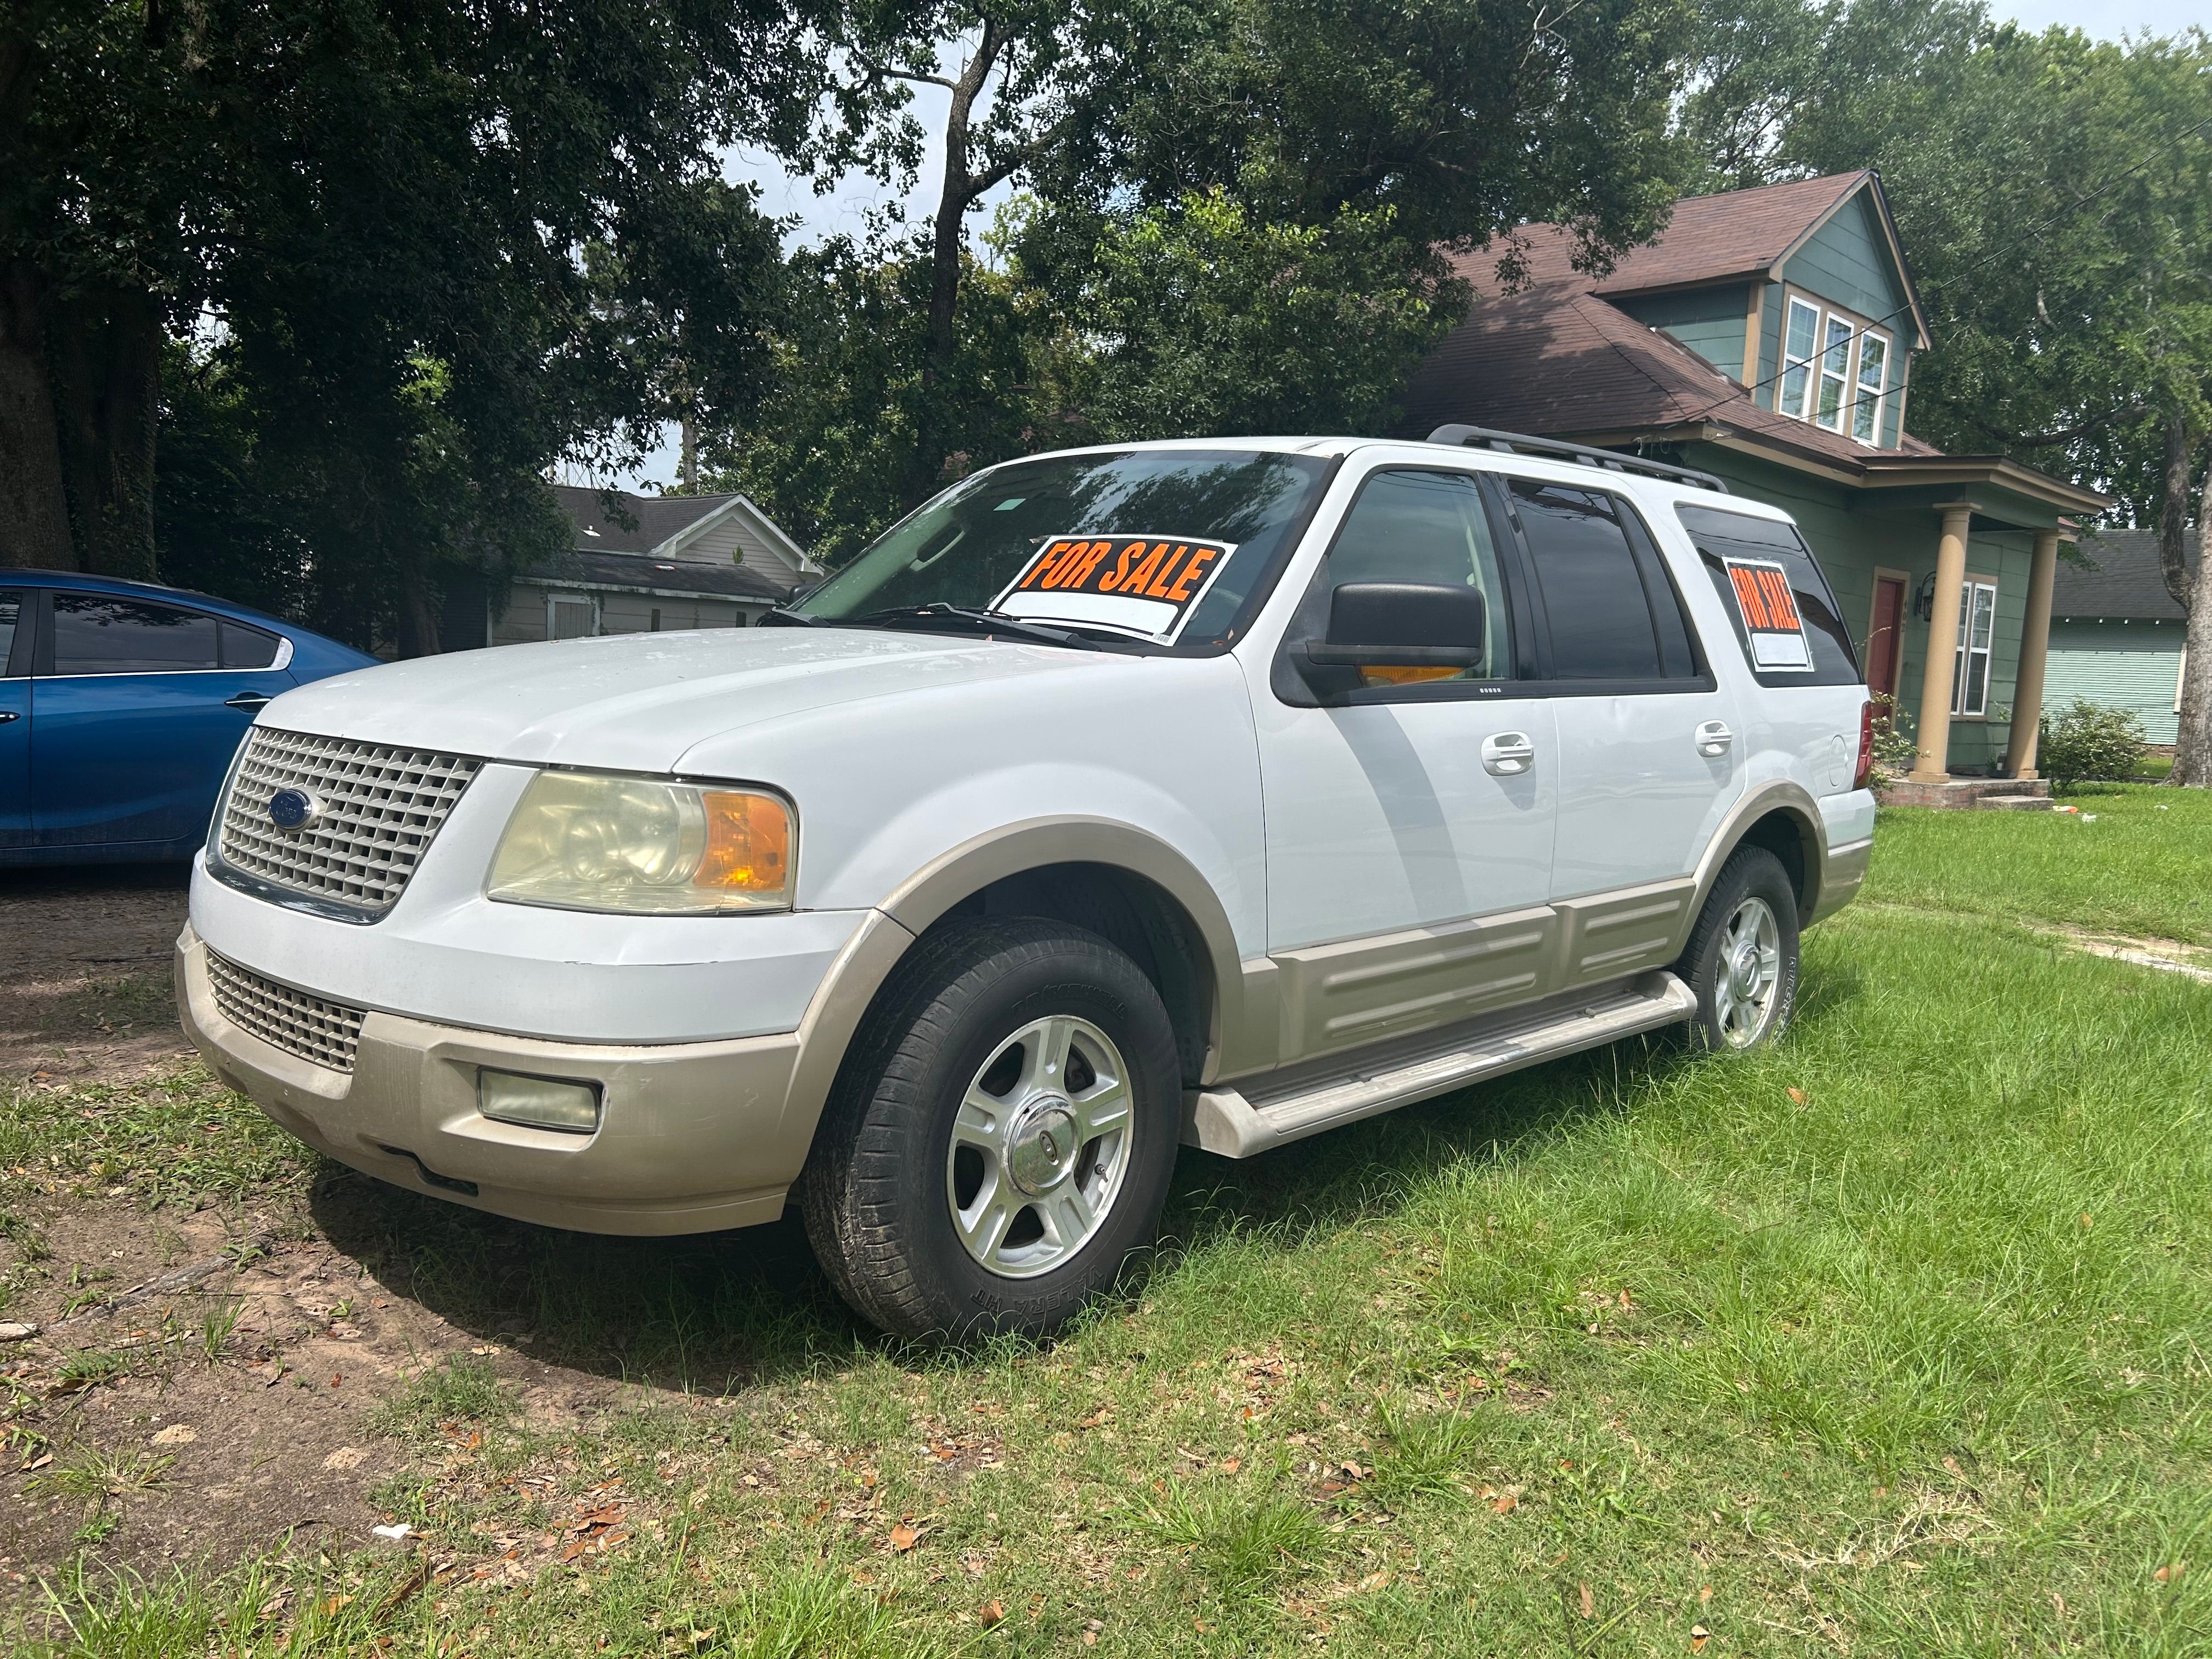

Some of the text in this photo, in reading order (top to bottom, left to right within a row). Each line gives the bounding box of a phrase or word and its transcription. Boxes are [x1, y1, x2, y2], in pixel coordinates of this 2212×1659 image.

[1020, 541, 1216, 602] FOR SALE
[1730, 567, 1800, 630] FOR SALE
[1014, 1265, 1104, 1317] VALERA
